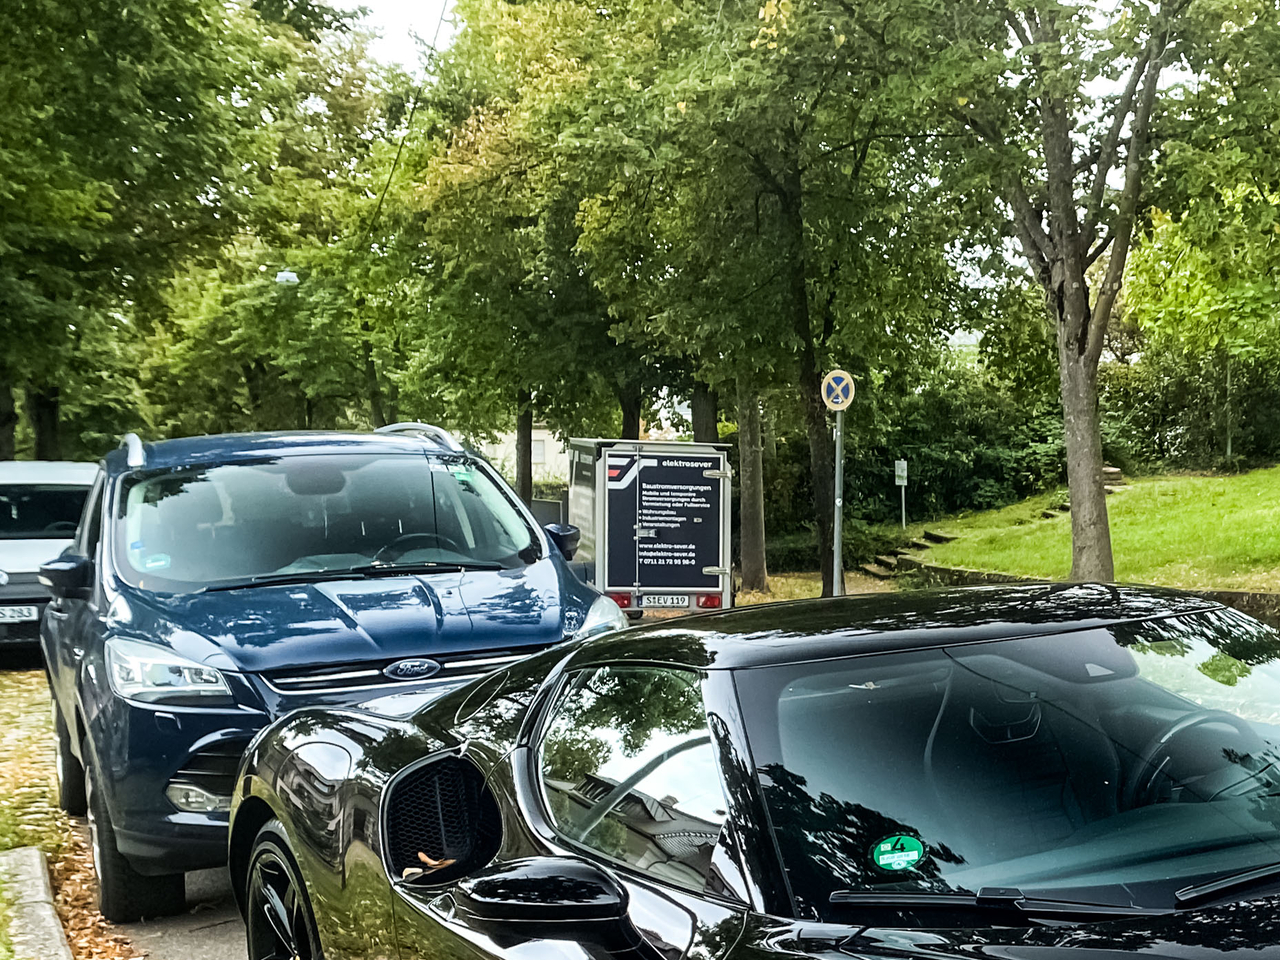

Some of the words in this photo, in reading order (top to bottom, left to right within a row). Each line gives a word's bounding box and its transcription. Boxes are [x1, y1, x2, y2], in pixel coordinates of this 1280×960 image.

[662, 460, 712, 468] elektrosever
[642, 483, 712, 491] Baustromversorgungen
[397, 661, 428, 675] Ford
[891, 837, 906, 852] 4
